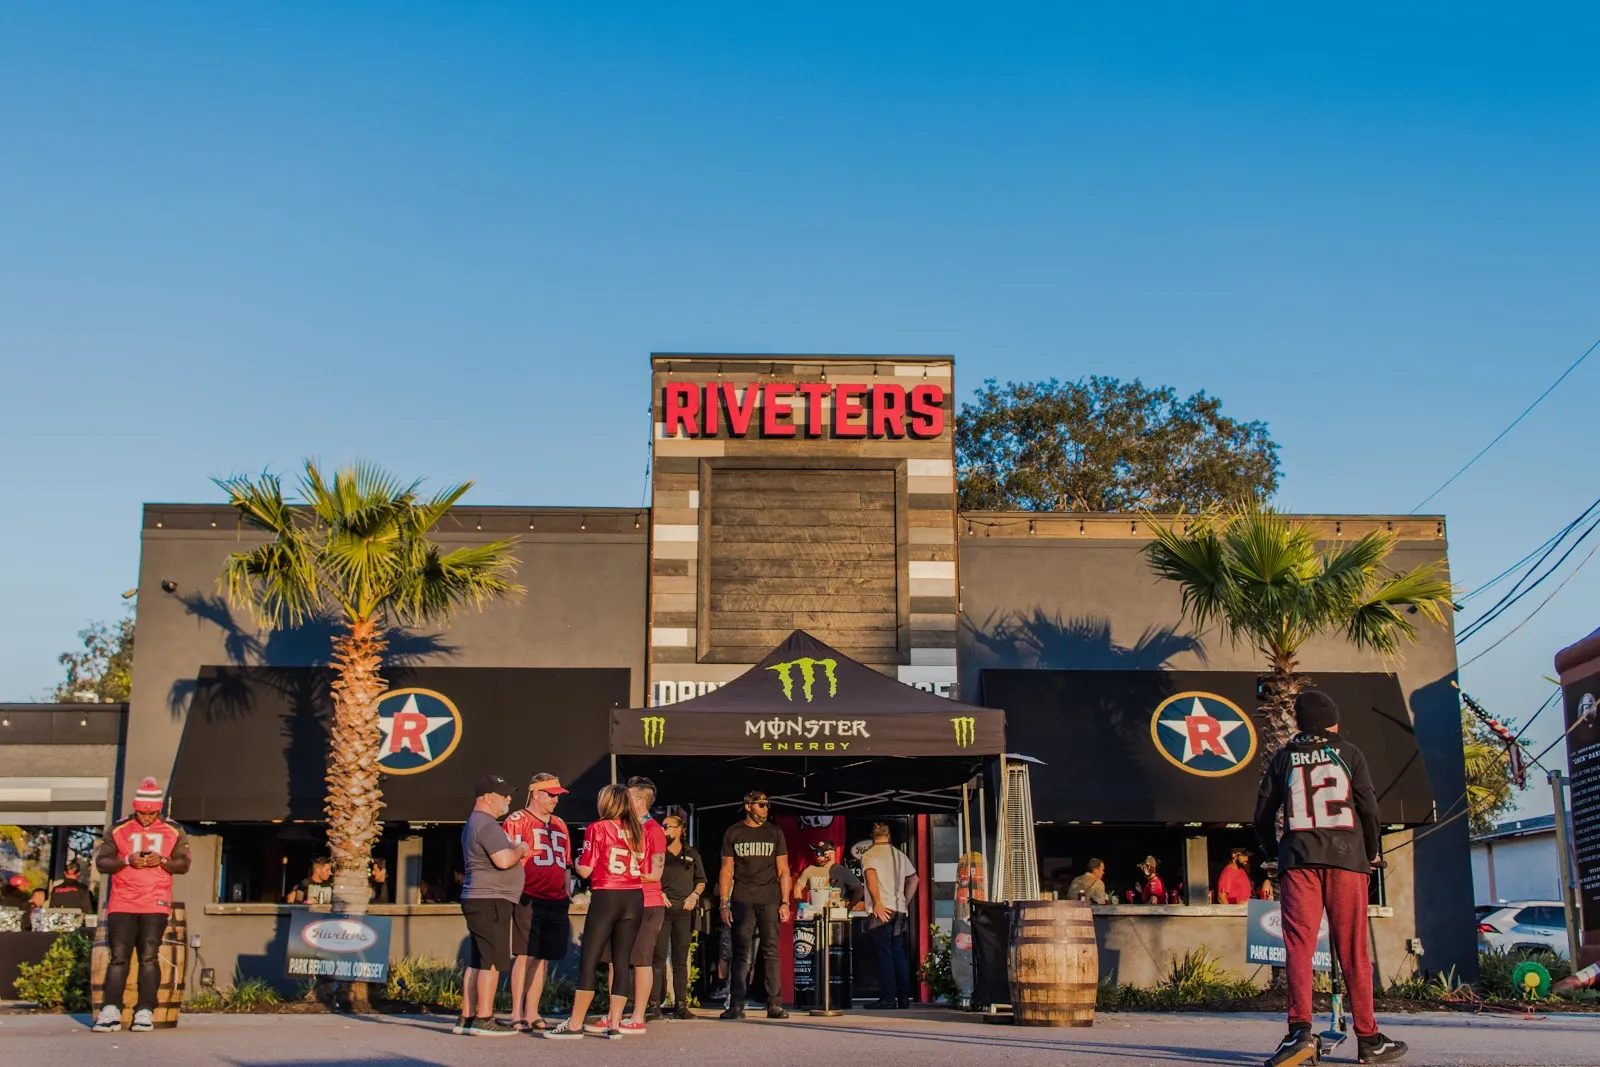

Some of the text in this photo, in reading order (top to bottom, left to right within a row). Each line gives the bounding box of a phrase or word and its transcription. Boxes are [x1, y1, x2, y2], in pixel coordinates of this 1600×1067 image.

[665, 381, 946, 437] RIVETERS
[389, 711, 428, 753] R
[744, 716, 871, 740] MONSTER
[1185, 715, 1228, 756] R
[762, 742, 850, 751] ENERGY
[1288, 762, 1354, 831] 12
[532, 828, 566, 870] 55
[734, 841, 775, 857] SECURITY
[288, 957, 308, 975] PARK
[308, 959, 335, 977] BEHIND
[353, 962, 384, 978] ODYSSEY
[1250, 945, 1268, 961] PARK
